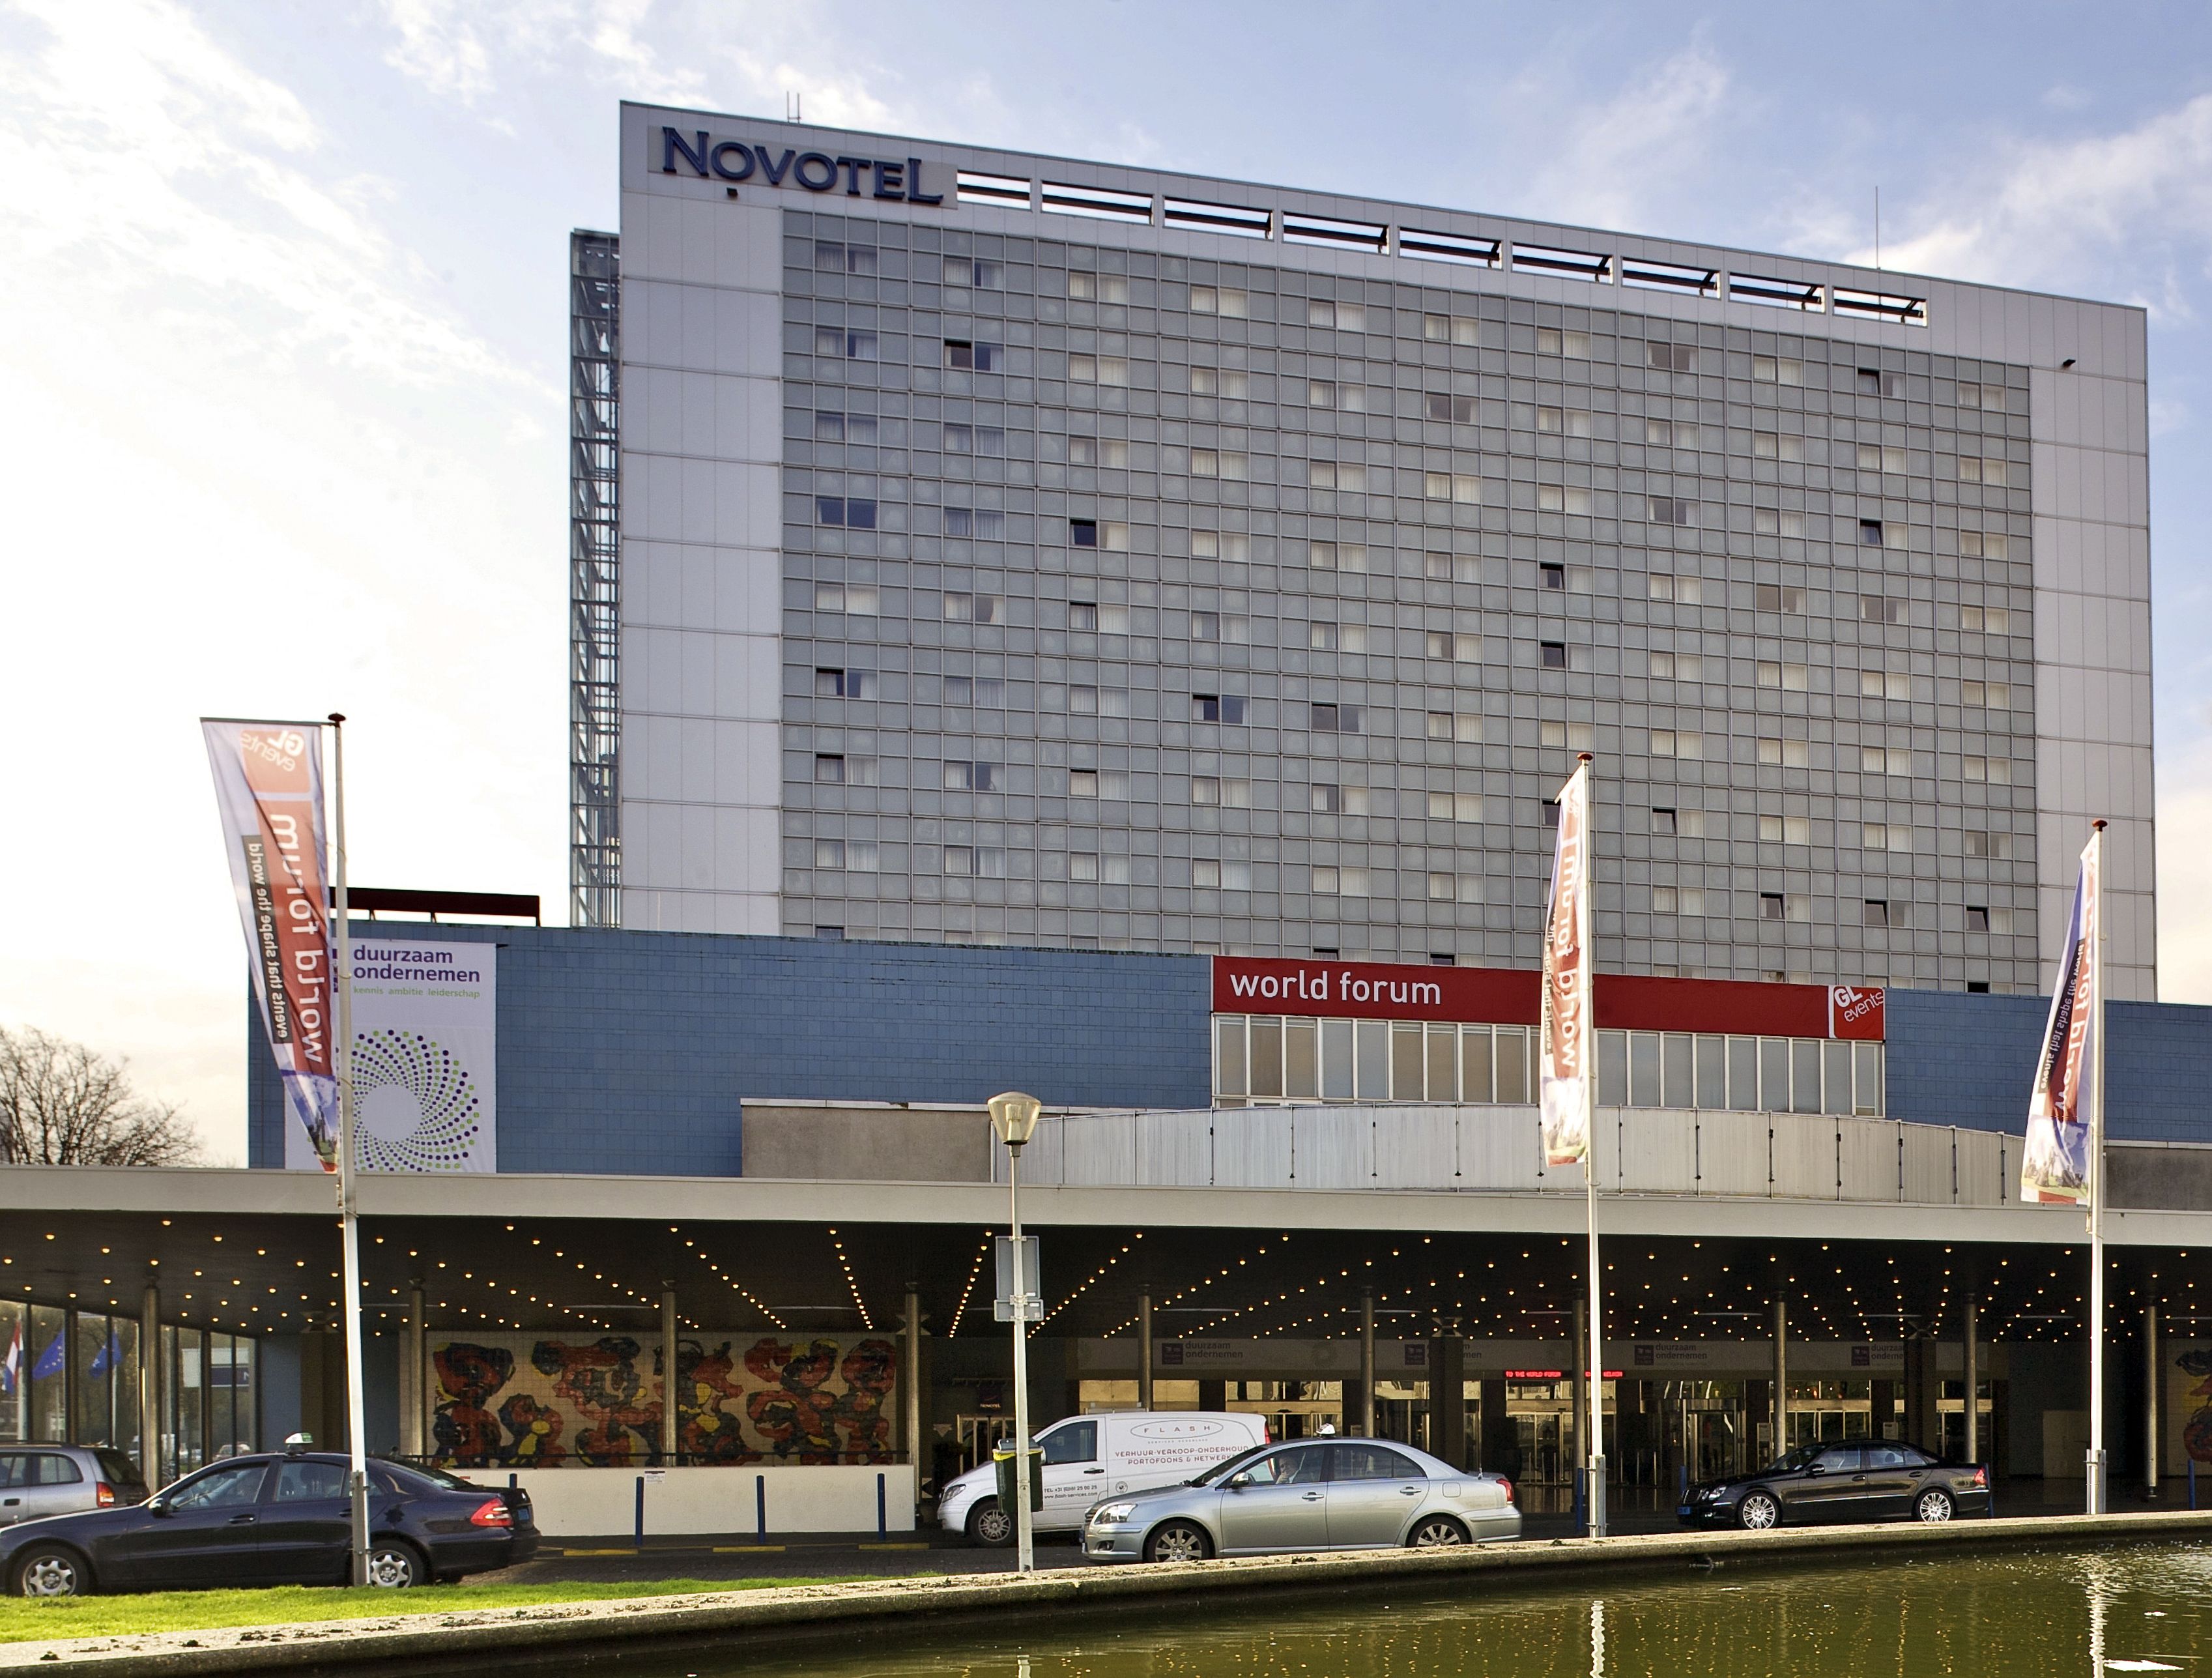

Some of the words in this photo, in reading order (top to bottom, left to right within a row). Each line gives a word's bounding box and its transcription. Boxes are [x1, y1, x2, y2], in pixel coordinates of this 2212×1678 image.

[662, 126, 943, 205] NOVOTEL
[354, 945, 453, 963] duurzaam
[354, 964, 480, 982] ondernemen
[353, 986, 384, 994] kennis
[388, 987, 424, 996] ambitie
[429, 989, 480, 999] leiderschap
[1230, 970, 1328, 1000] world
[1340, 972, 1441, 1005] forum
[1834, 985, 1863, 1007] GL
[1844, 991, 1884, 1022] events
[1128, 1456, 1183, 1465] PORTOFOONS
